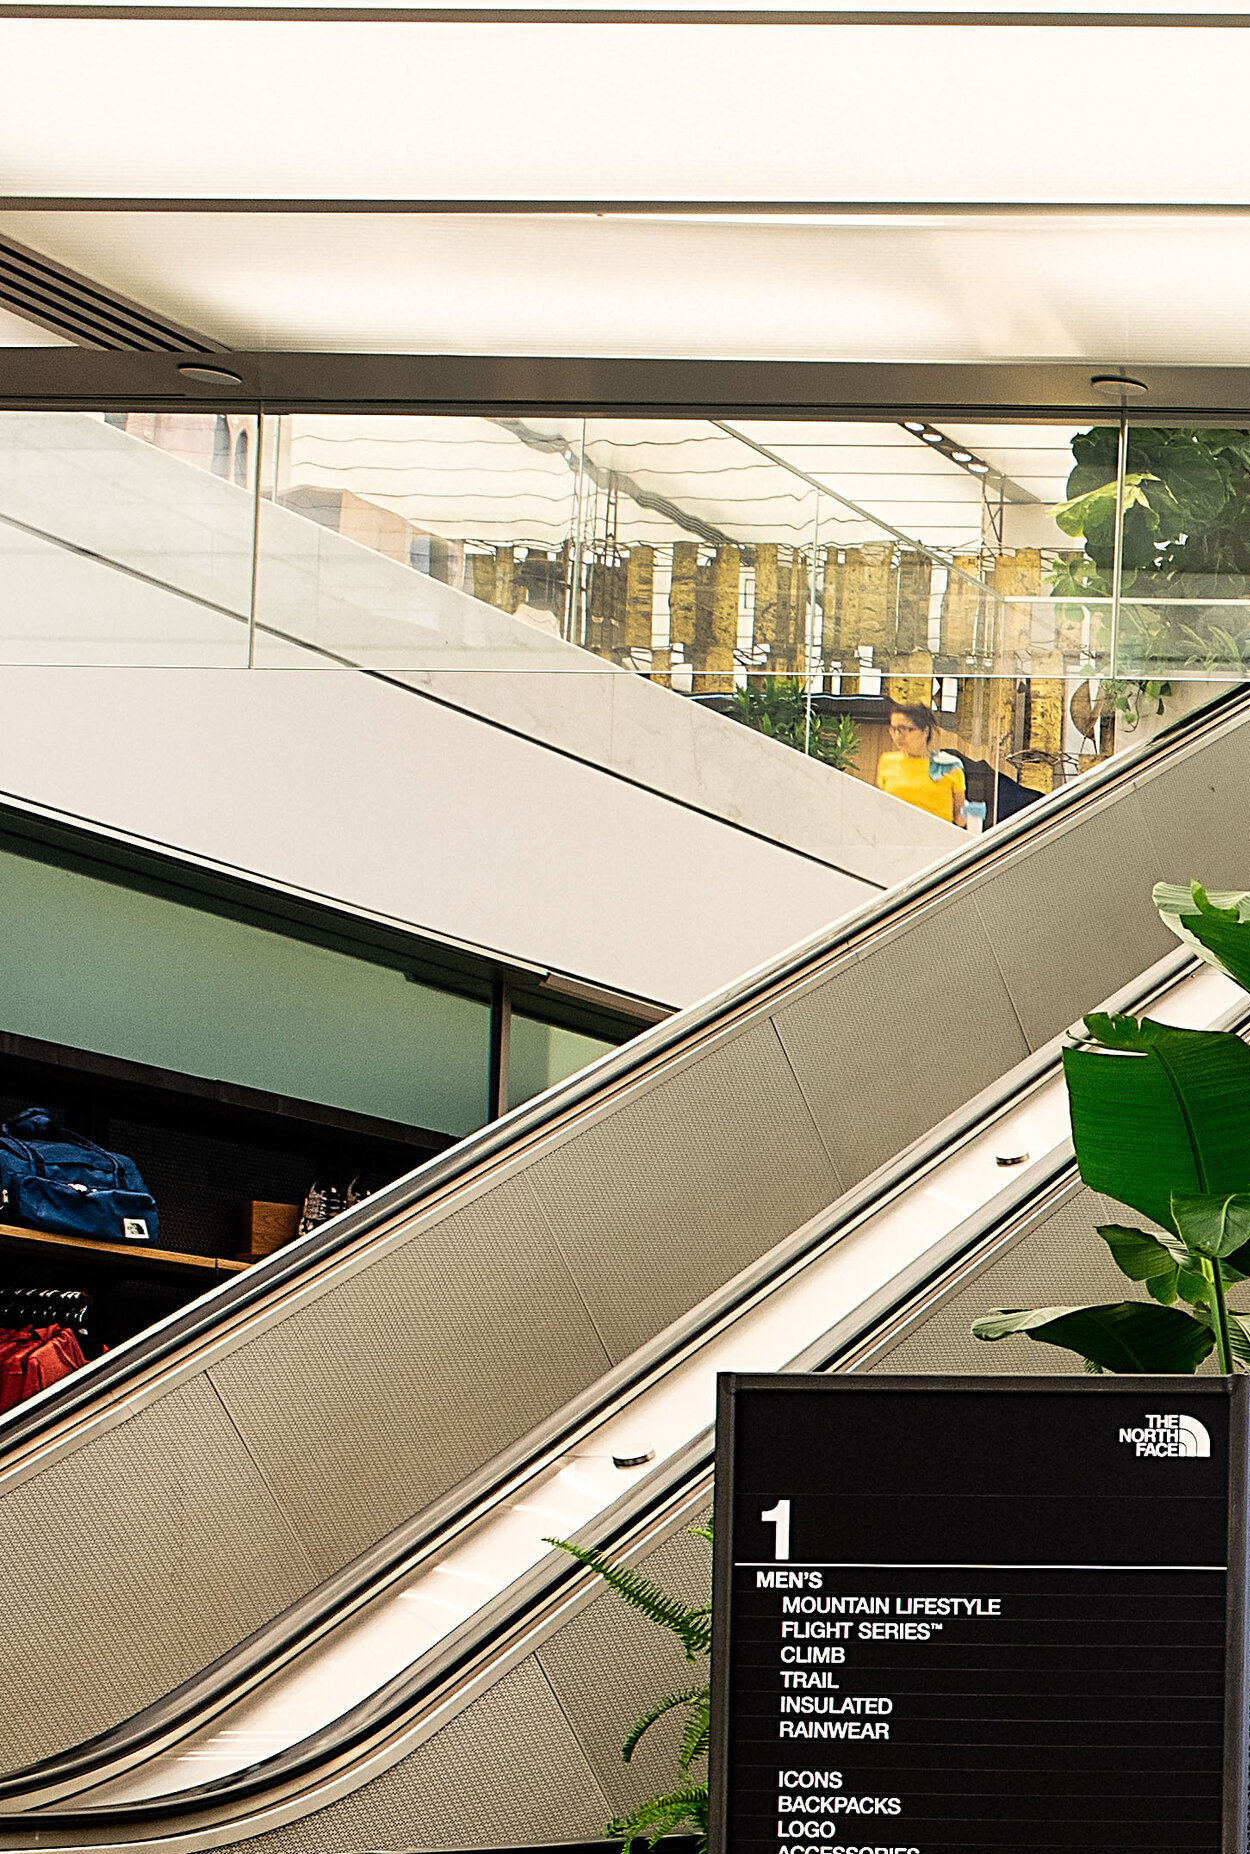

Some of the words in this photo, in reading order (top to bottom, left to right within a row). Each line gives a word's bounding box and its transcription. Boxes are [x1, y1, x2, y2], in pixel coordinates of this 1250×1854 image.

[1145, 1415, 1179, 1429] THE
[1119, 1428, 1179, 1443] NORTH
[1136, 1442, 1179, 1457] FACE
[762, 1499, 791, 1560] 1
[757, 1571, 822, 1589] MEN'S
[782, 1596, 889, 1615] MOUNTAIN
[896, 1597, 1001, 1616] LIFESTYLE
[781, 1621, 853, 1639] FLIGHT
[780, 1646, 845, 1663] CLIMB
[780, 1671, 839, 1688] TRAIL
[780, 1696, 892, 1714] INSULATED
[779, 1721, 890, 1739] RAINWEAR
[778, 1771, 843, 1789] ICONS
[778, 1796, 902, 1814] BACKPACKS
[777, 1821, 836, 1838] LOGO
